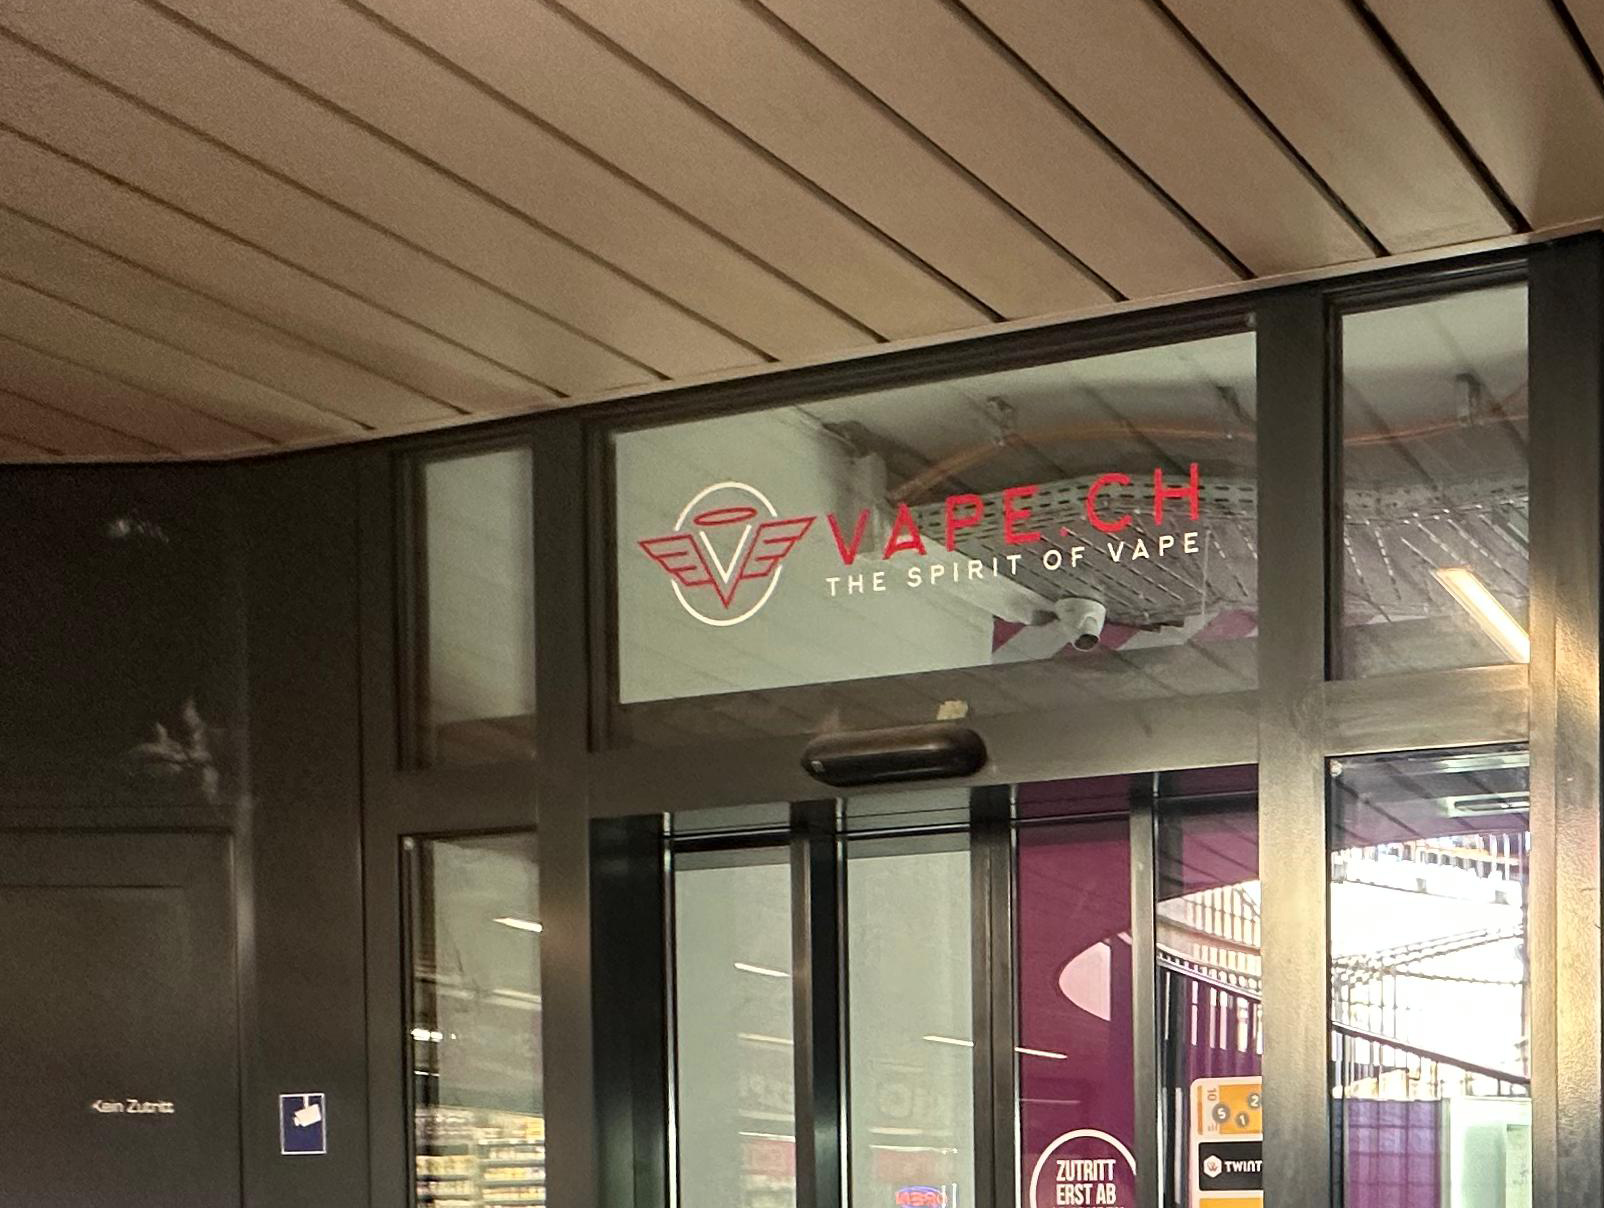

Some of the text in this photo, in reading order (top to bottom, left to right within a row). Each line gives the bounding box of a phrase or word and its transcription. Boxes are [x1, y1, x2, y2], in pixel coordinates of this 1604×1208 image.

[825, 462, 1200, 567] VAPE.CH
[825, 531, 1200, 597] THE SPIRIT OF VAPE
[1250, 1094, 1260, 1108] 2
[1056, 1159, 1117, 1181] ZUTRITT
[1224, 1160, 1263, 1173] TWINT
[1056, 1183, 1117, 1206] ERST AB
